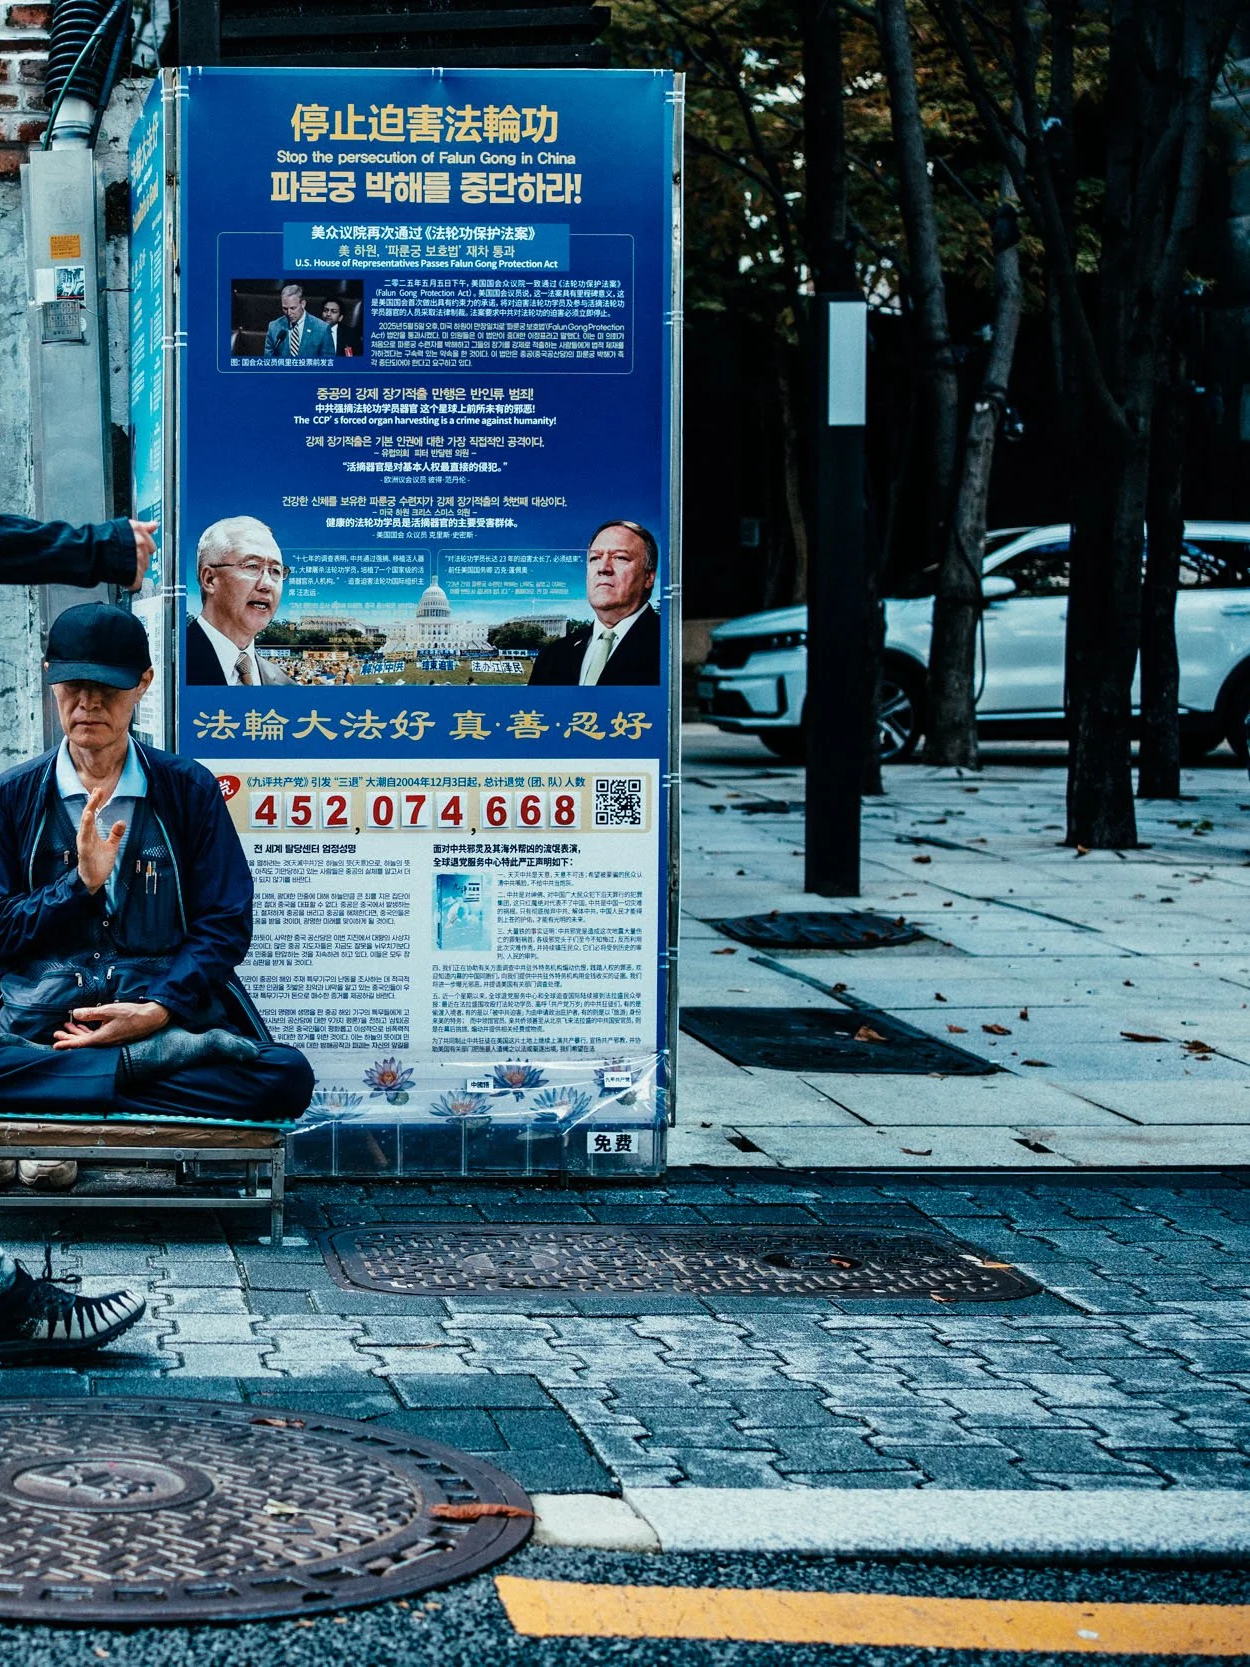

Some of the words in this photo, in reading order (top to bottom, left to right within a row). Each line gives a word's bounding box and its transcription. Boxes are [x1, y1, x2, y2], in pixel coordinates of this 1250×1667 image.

[290, 103, 559, 144] 停止迫害法輪功
[276, 149, 309, 165] Stop
[311, 150, 334, 164] the
[337, 150, 417, 166] persecution
[420, 151, 435, 165] of
[439, 151, 476, 165] Falun
[479, 151, 517, 167] Gong
[521, 151, 534, 165] in
[537, 151, 576, 165] China
[270, 170, 357, 204] 파룬궁
[365, 171, 452, 204] 박해를
[459, 171, 582, 205] 중단하라!
[311, 224, 536, 241] 美众议院再次通过《法轮功保护法案》
[338, 244, 351, 258] 美
[353, 244, 380, 258] 하원,
[465, 244, 490, 258] 재차
[492, 244, 516, 259] 통과
[295, 258, 312, 269] U.S.
[313, 258, 341, 269] House
[341, 258, 351, 269] of
[351, 258, 420, 269] Representatives
[420, 258, 450, 269] Passes
[450, 258, 474, 269] Falun
[474, 258, 498, 270] Gong
[498, 258, 543, 269] Protection
[543, 258, 559, 269] Act
[399, 288, 419, 299] Gong
[421, 289, 456, 298] Protection
[316, 387, 352, 401] 중공의
[355, 387, 379, 401] 강제
[382, 387, 429, 401] 장기적출
[431, 387, 467, 401] 만행은
[470, 387, 505, 401] 반인류
[508, 387, 534, 401] 범죄!
[293, 415, 310, 425] The
[339, 415, 368, 425] forced
[368, 417, 394, 427] organ
[394, 415, 440, 427] harvesting
[440, 415, 449, 425] is
[448, 417, 455, 425] a
[455, 415, 481, 425] crime
[481, 415, 513, 427] against
[513, 415, 557, 427] humanity!
[305, 435, 325, 448] 강제
[326, 435, 373, 448] 장기적출은
[375, 435, 394, 448] 기본
[396, 435, 424, 448] 인권에
[426, 435, 445, 448] 대한
[447, 435, 467, 448] 가장
[469, 435, 505, 448] 직접적인
[506, 436, 545, 448] 공격이다.
[282, 495, 309, 508] 건강한
[311, 495, 338, 507] 신체를
[339, 495, 367, 507] 보유한
[369, 495, 397, 508] 파룬궁
[398, 495, 434, 507] 수련자가
[436, 495, 455, 508] 강제
[456, 495, 500, 508] 장기적출의
[502, 495, 529, 508] 첫번째
[531, 496, 568, 508] 대상이다.
[192, 708, 436, 742] 法輪大法好
[448, 709, 653, 741] 真·善·忍好
[253, 844, 263, 854] 전
[264, 844, 283, 854] 세계
[285, 844, 320, 854] 탈당센터
[322, 844, 357, 854] 엄정성명
[594, 1134, 632, 1153] 免费
